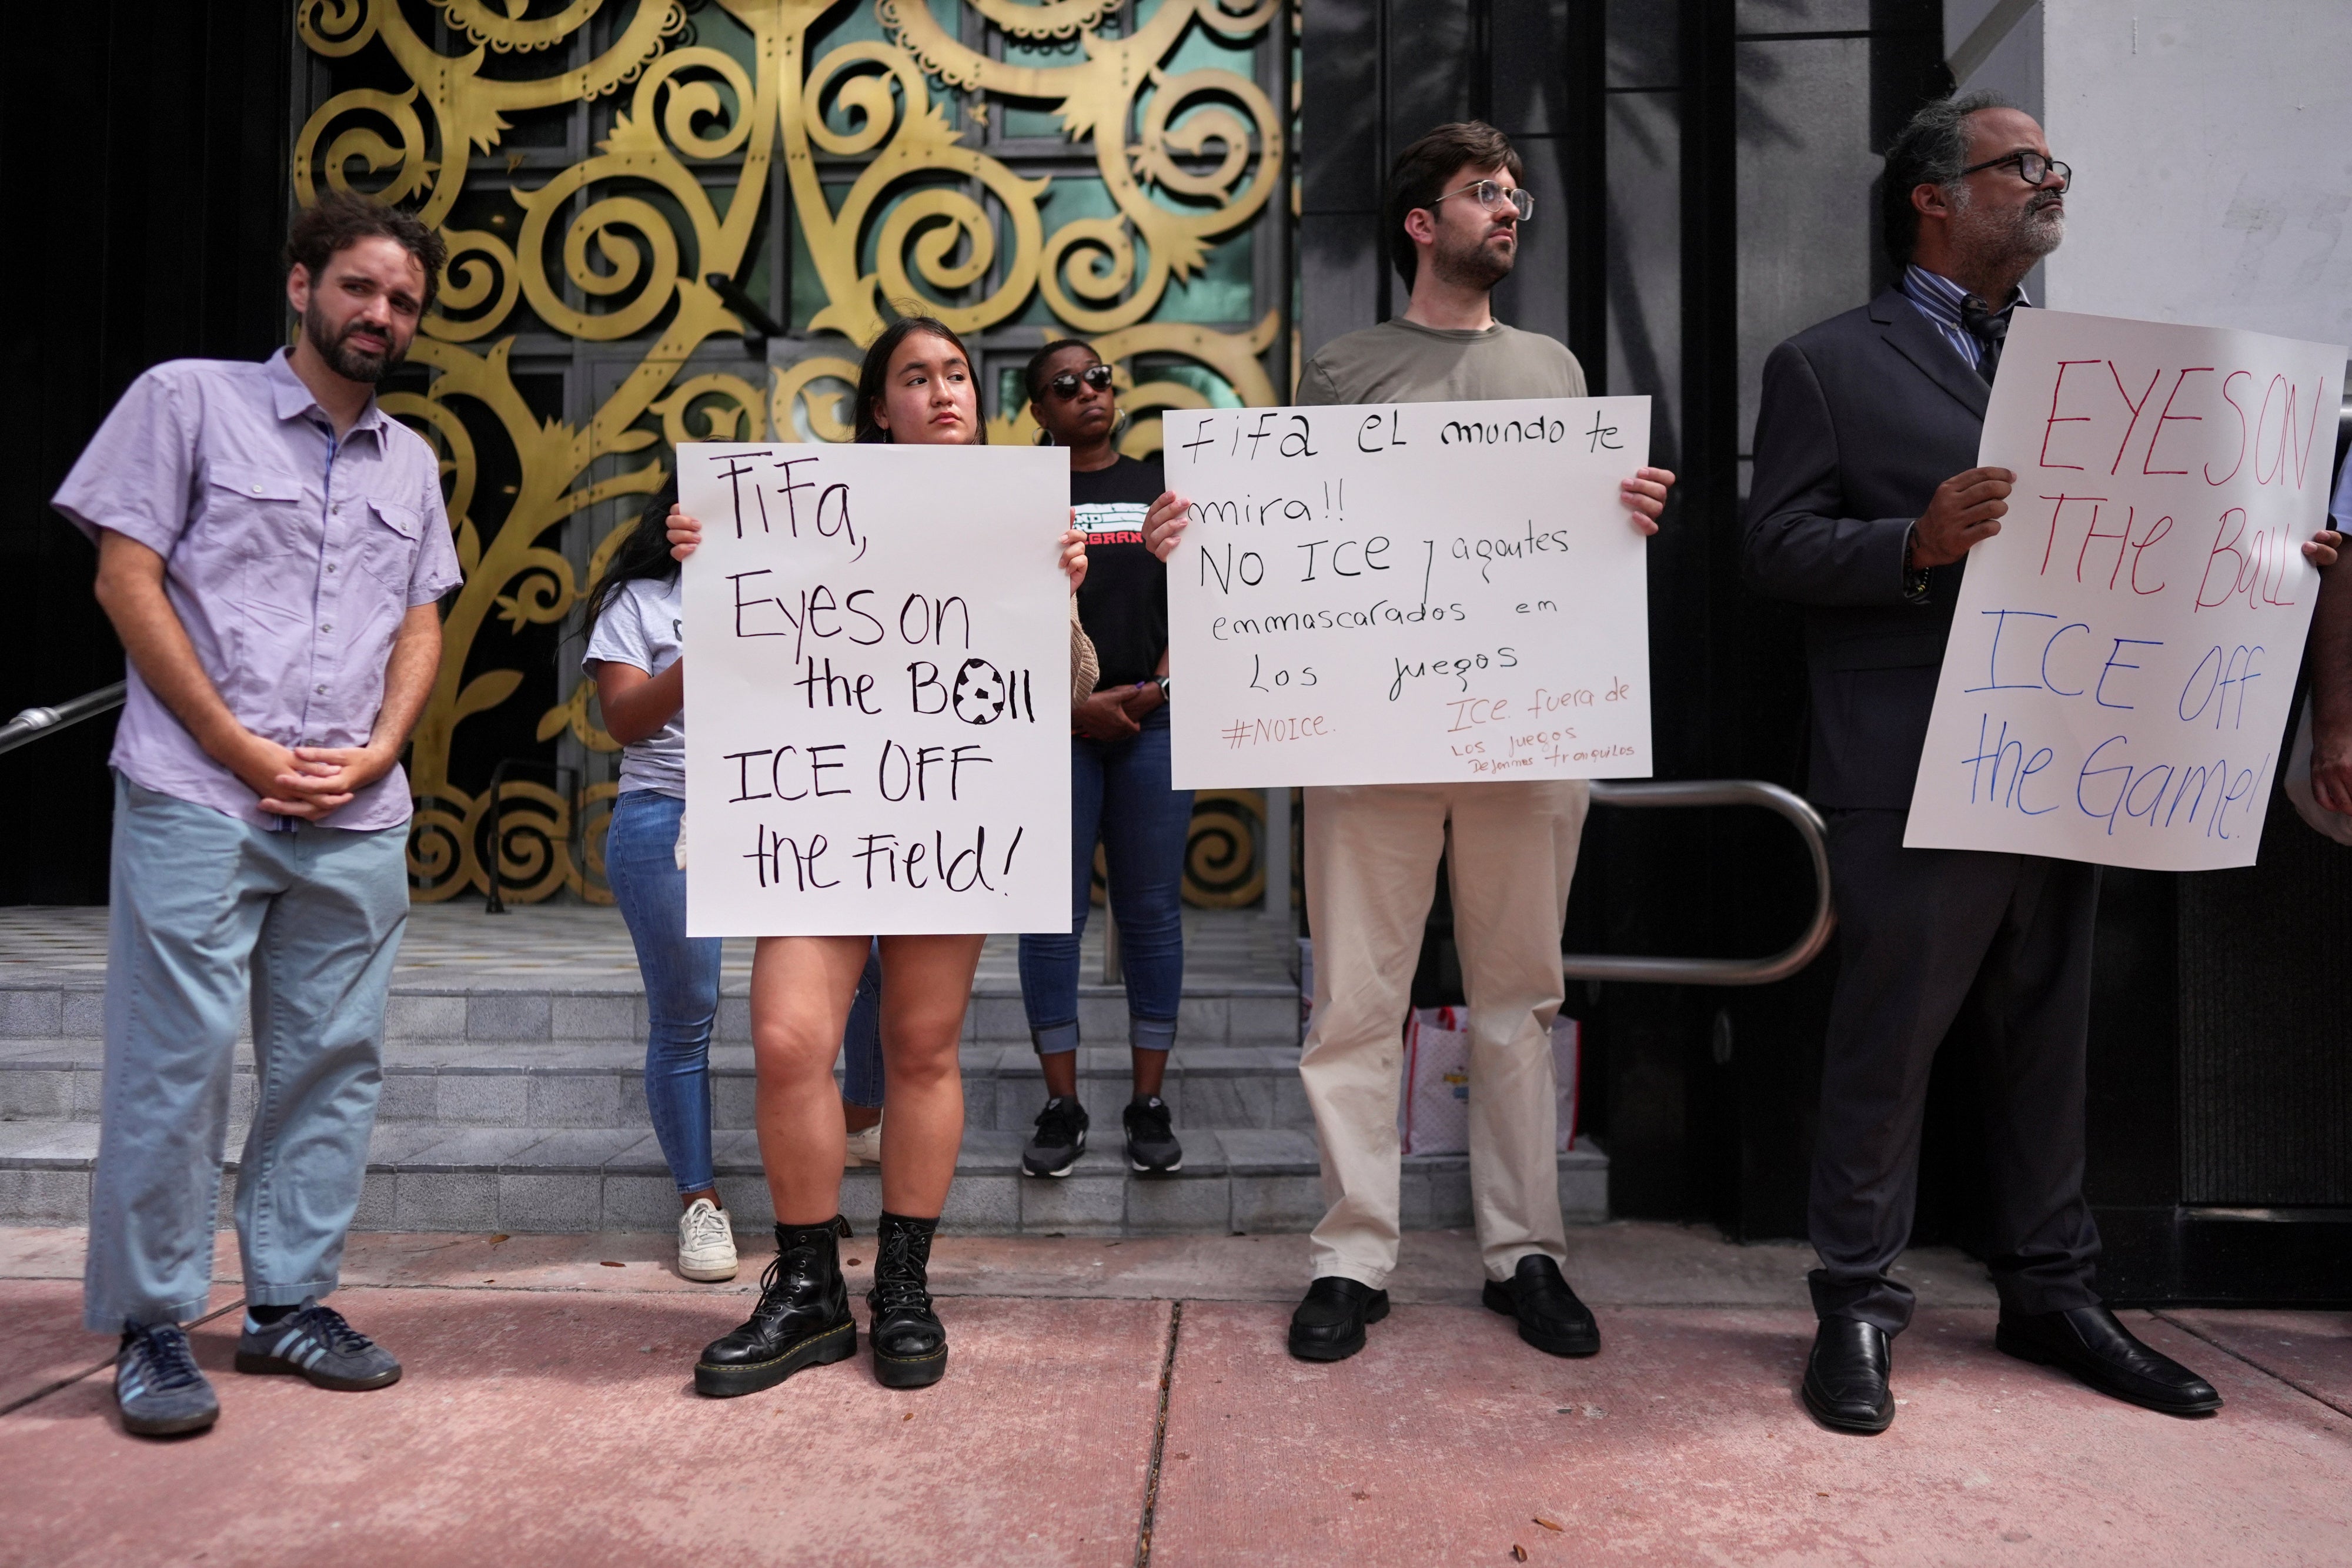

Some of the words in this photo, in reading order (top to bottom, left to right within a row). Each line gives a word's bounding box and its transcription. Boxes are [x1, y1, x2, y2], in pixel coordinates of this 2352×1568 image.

[1441, 415, 1565, 444] mundo
[1586, 410, 1624, 453] te
[724, 569, 884, 664] Eyes
[900, 593, 969, 650] on
[793, 654, 882, 715] the
[1389, 647, 1518, 703] juegos
[1964, 609, 2164, 709] ICE
[1528, 689, 1594, 719] fuera
[1605, 676, 1629, 701] de
[723, 744, 851, 803] ICE
[879, 740, 993, 802] OFF
[1509, 727, 1579, 759] juegos
[1962, 713, 2059, 815] the
[2077, 735, 2272, 842] Game!
[742, 824, 841, 892] the
